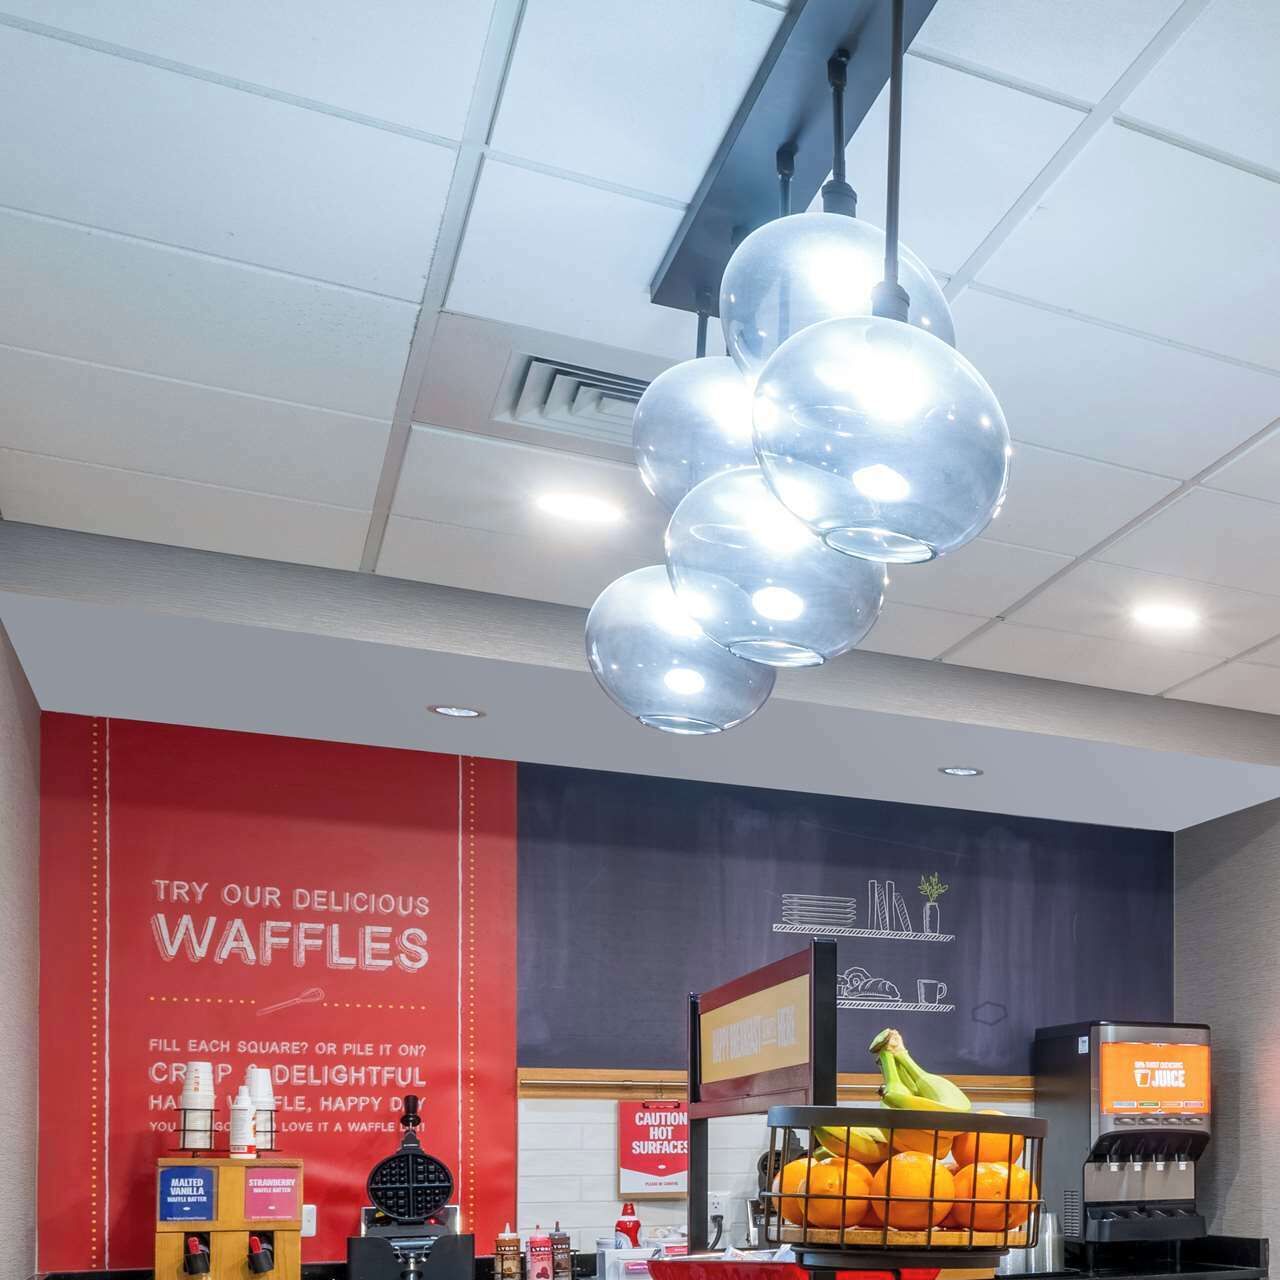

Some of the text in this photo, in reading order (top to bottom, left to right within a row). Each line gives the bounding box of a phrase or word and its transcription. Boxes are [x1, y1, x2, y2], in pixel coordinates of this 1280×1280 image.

[152, 879, 430, 917] TRY OUR DELICIOUS
[151, 913, 429, 973] WAFFLES
[149, 1038, 427, 1057] FILL EACH SQUARE? OR PILE IT ON?
[149, 1062, 232, 1086] CRP
[272, 1064, 427, 1087] DELIGHTFUL
[1152, 1069, 1185, 1088] JUICE
[320, 1096, 383, 1112] HAPPY
[390, 1096, 426, 1112] DY
[635, 1112, 688, 1126] CAUTION
[281, 1122, 313, 1133] LOVE
[318, 1122, 329, 1133] IT
[334, 1122, 342, 1133] A
[347, 1122, 395, 1133] WAFFLE
[649, 1126, 674, 1139] HOT
[171, 1178, 204, 1187] MALTED
[170, 1186, 205, 1196] VANILLA
